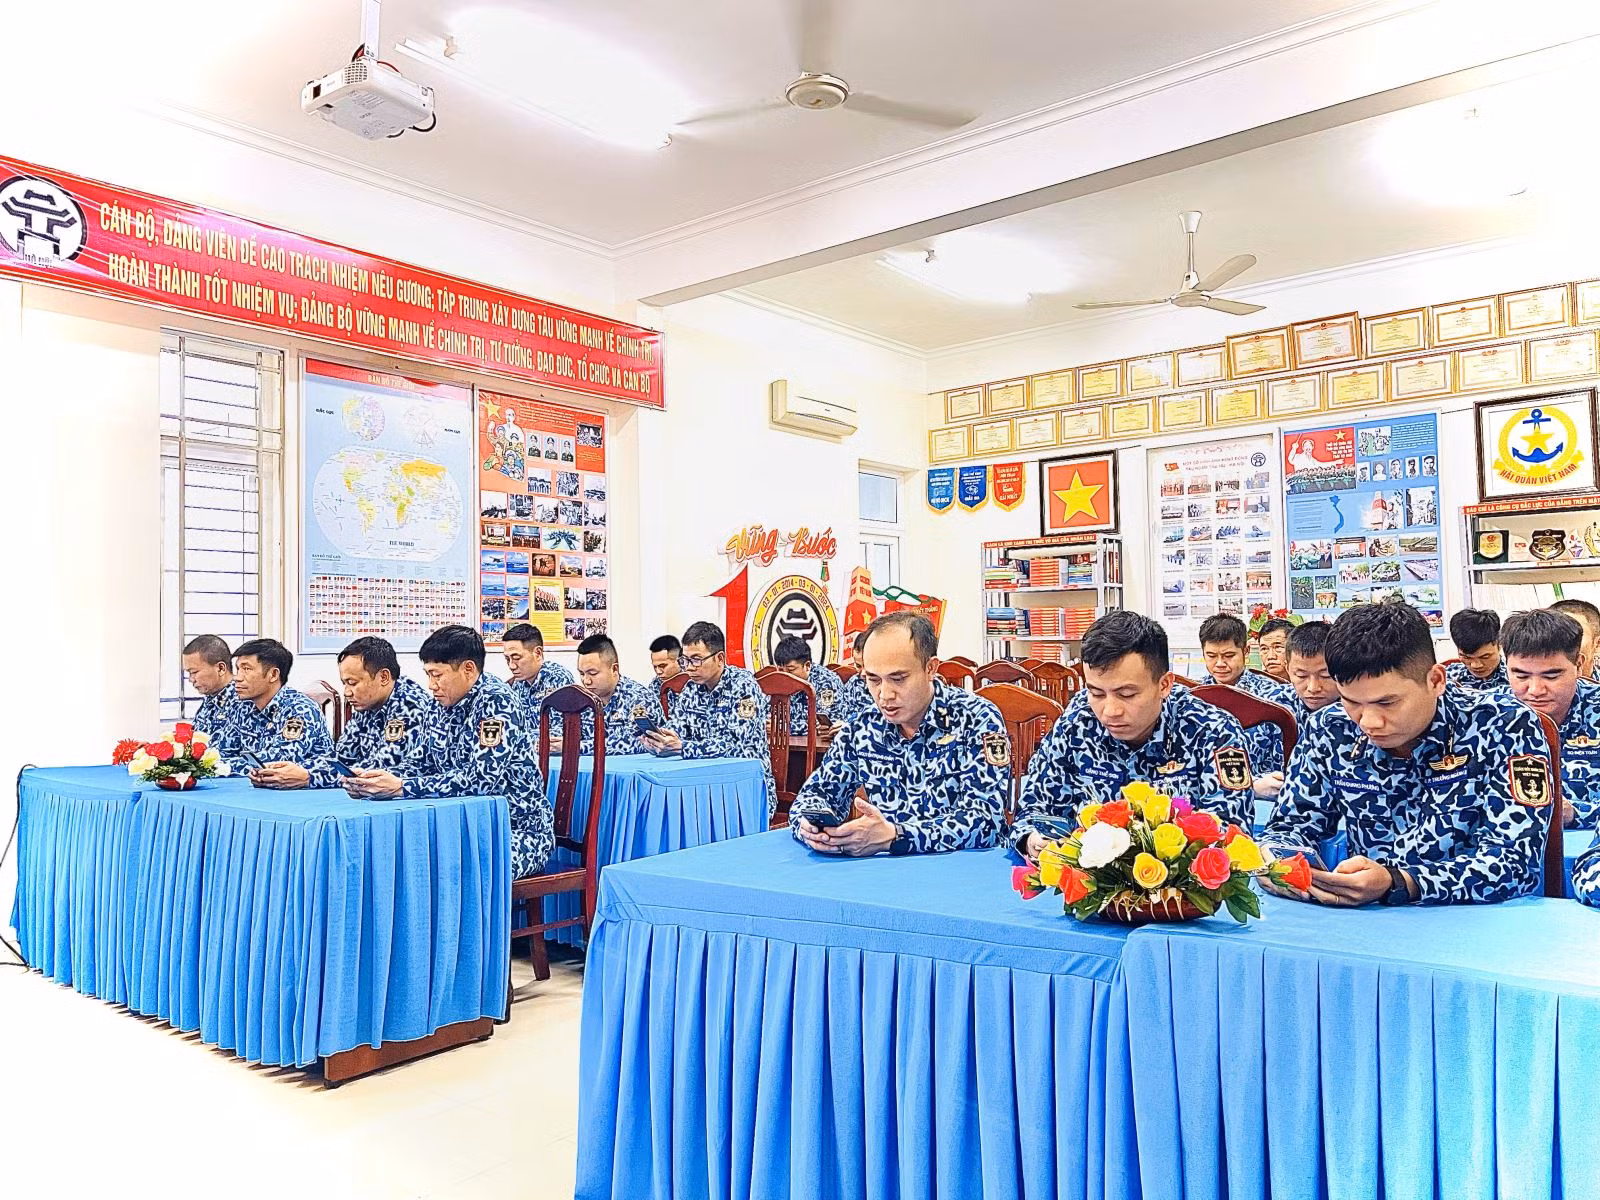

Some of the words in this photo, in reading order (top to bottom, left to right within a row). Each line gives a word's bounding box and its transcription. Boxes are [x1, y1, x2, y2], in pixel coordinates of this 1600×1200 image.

[100, 200, 131, 236] CÁN
[135, 208, 159, 247] BỘ,
[163, 213, 202, 253] ĐẢNG
[205, 227, 237, 262] VIÊN
[261, 244, 286, 273] CAO
[289, 251, 328, 284] TRÁCH
[331, 262, 369, 297] NHIỆM
[371, 269, 394, 300] NÊU
[396, 278, 435, 312] GƯƠNG;
[437, 286, 456, 318] TẬP
[458, 294, 489, 323] TRUNG
[491, 300, 510, 327] XÂY
[512, 308, 536, 336] DỰNG
[537, 311, 554, 338] TÀU
[555, 316, 578, 344] VỮNG
[580, 325, 604, 352] MẠNH
[616, 333, 639, 358] CHÍNH
[108, 251, 149, 288] HOÀN
[153, 261, 200, 299] THÀNH
[204, 267, 229, 305] TỐT
[232, 281, 275, 318] NHIỆM
[301, 291, 334, 328] ĐẢNG
[337, 302, 353, 337] BỘ
[355, 306, 386, 339] VỮNG
[388, 316, 420, 347] MẠNH
[437, 326, 468, 356] CHÍNH
[490, 339, 502, 363] TƯ
[537, 350, 555, 377] ĐẠO
[589, 360, 610, 386] CHỨC
[611, 364, 622, 389] VÀ
[623, 366, 639, 392] CÁN
[640, 373, 651, 398] BỘ
[1558, 463, 1577, 478] NAM
